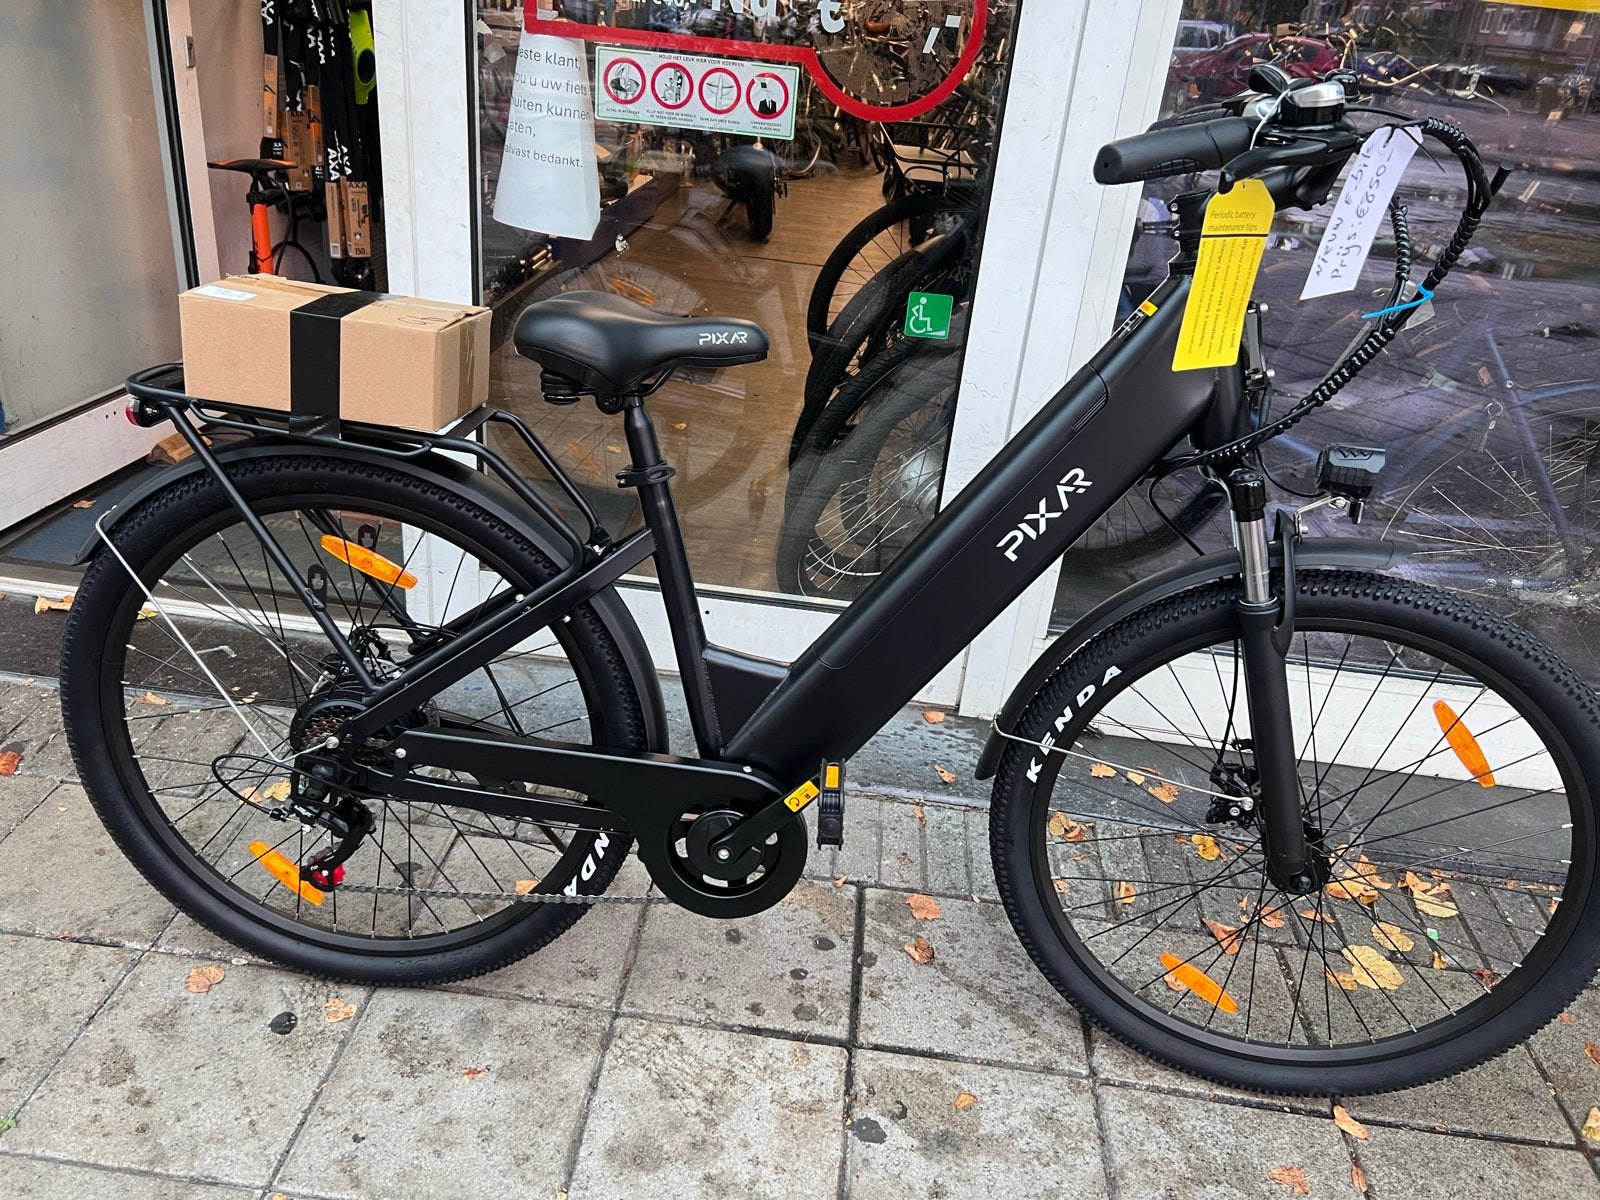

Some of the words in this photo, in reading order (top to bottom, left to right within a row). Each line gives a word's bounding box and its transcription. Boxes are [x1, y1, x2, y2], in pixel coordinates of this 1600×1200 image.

[518, 48, 541, 62] este
[545, 50, 581, 71] klant,
[721, 60, 744, 68] IEDEREEN
[515, 72, 526, 84] ou
[529, 76, 537, 87] u
[541, 78, 561, 93] uw
[565, 80, 588, 96] fiets
[546, 102, 590, 121] kunnen
[508, 121, 536, 138] aten,
[327, 147, 340, 181] AXA
[533, 149, 583, 168] bedankt.
[1210, 210, 1234, 219] Periodic
[1234, 210, 1257, 220] battery
[1207, 223, 1245, 232] maintenance
[1245, 223, 1258, 232] tips
[698, 331, 748, 346] PIXAR
[996, 467, 1093, 562] PIXAR
[1026, 665, 1122, 783] KENDA
[563, 831, 610, 897] NDA
